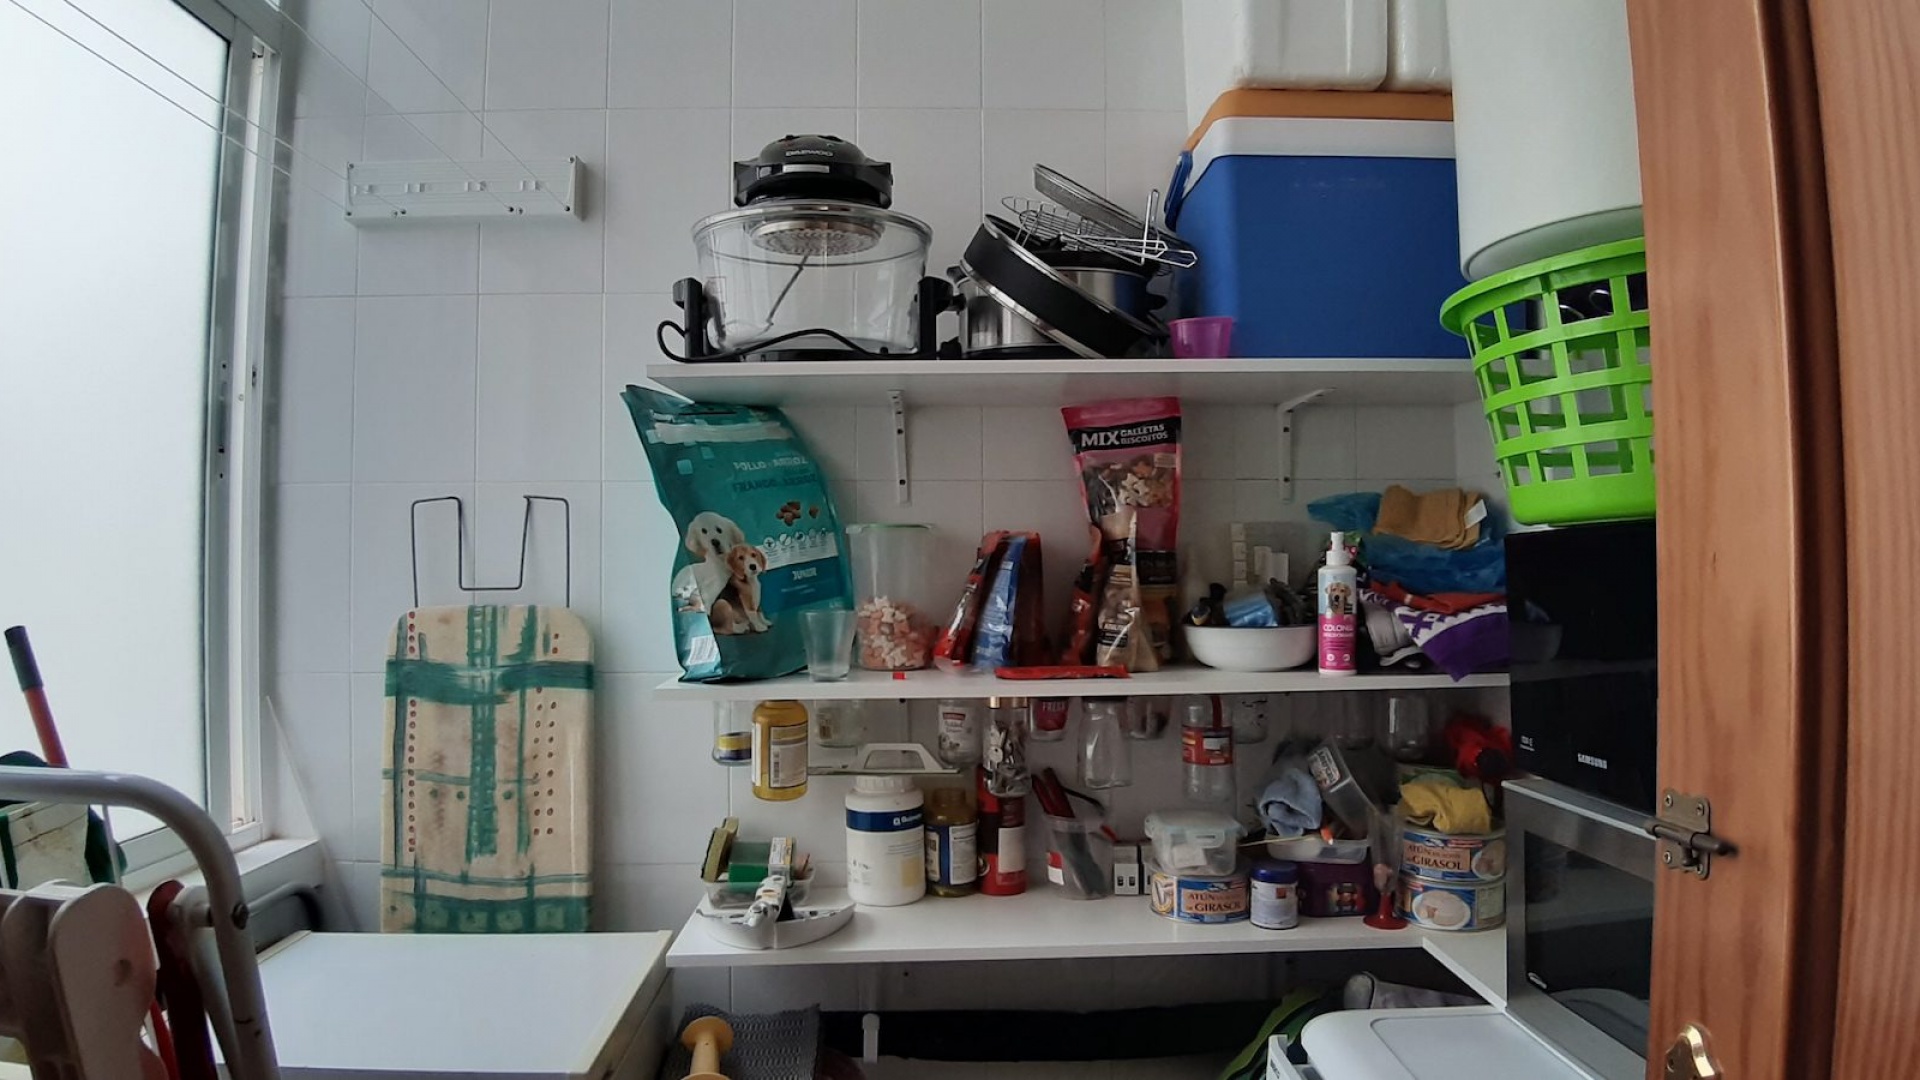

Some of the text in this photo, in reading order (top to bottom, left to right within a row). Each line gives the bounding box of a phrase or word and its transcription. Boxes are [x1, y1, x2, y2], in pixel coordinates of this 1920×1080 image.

[1081, 424, 1165, 447] MIX GALLETAS
[1120, 431, 1168, 445] BISCOITOS
[1578, 753, 1607, 769] SAMSUNG
[1412, 854, 1463, 870] GIRASOL
[1195, 901, 1242, 911] GIRASOL
